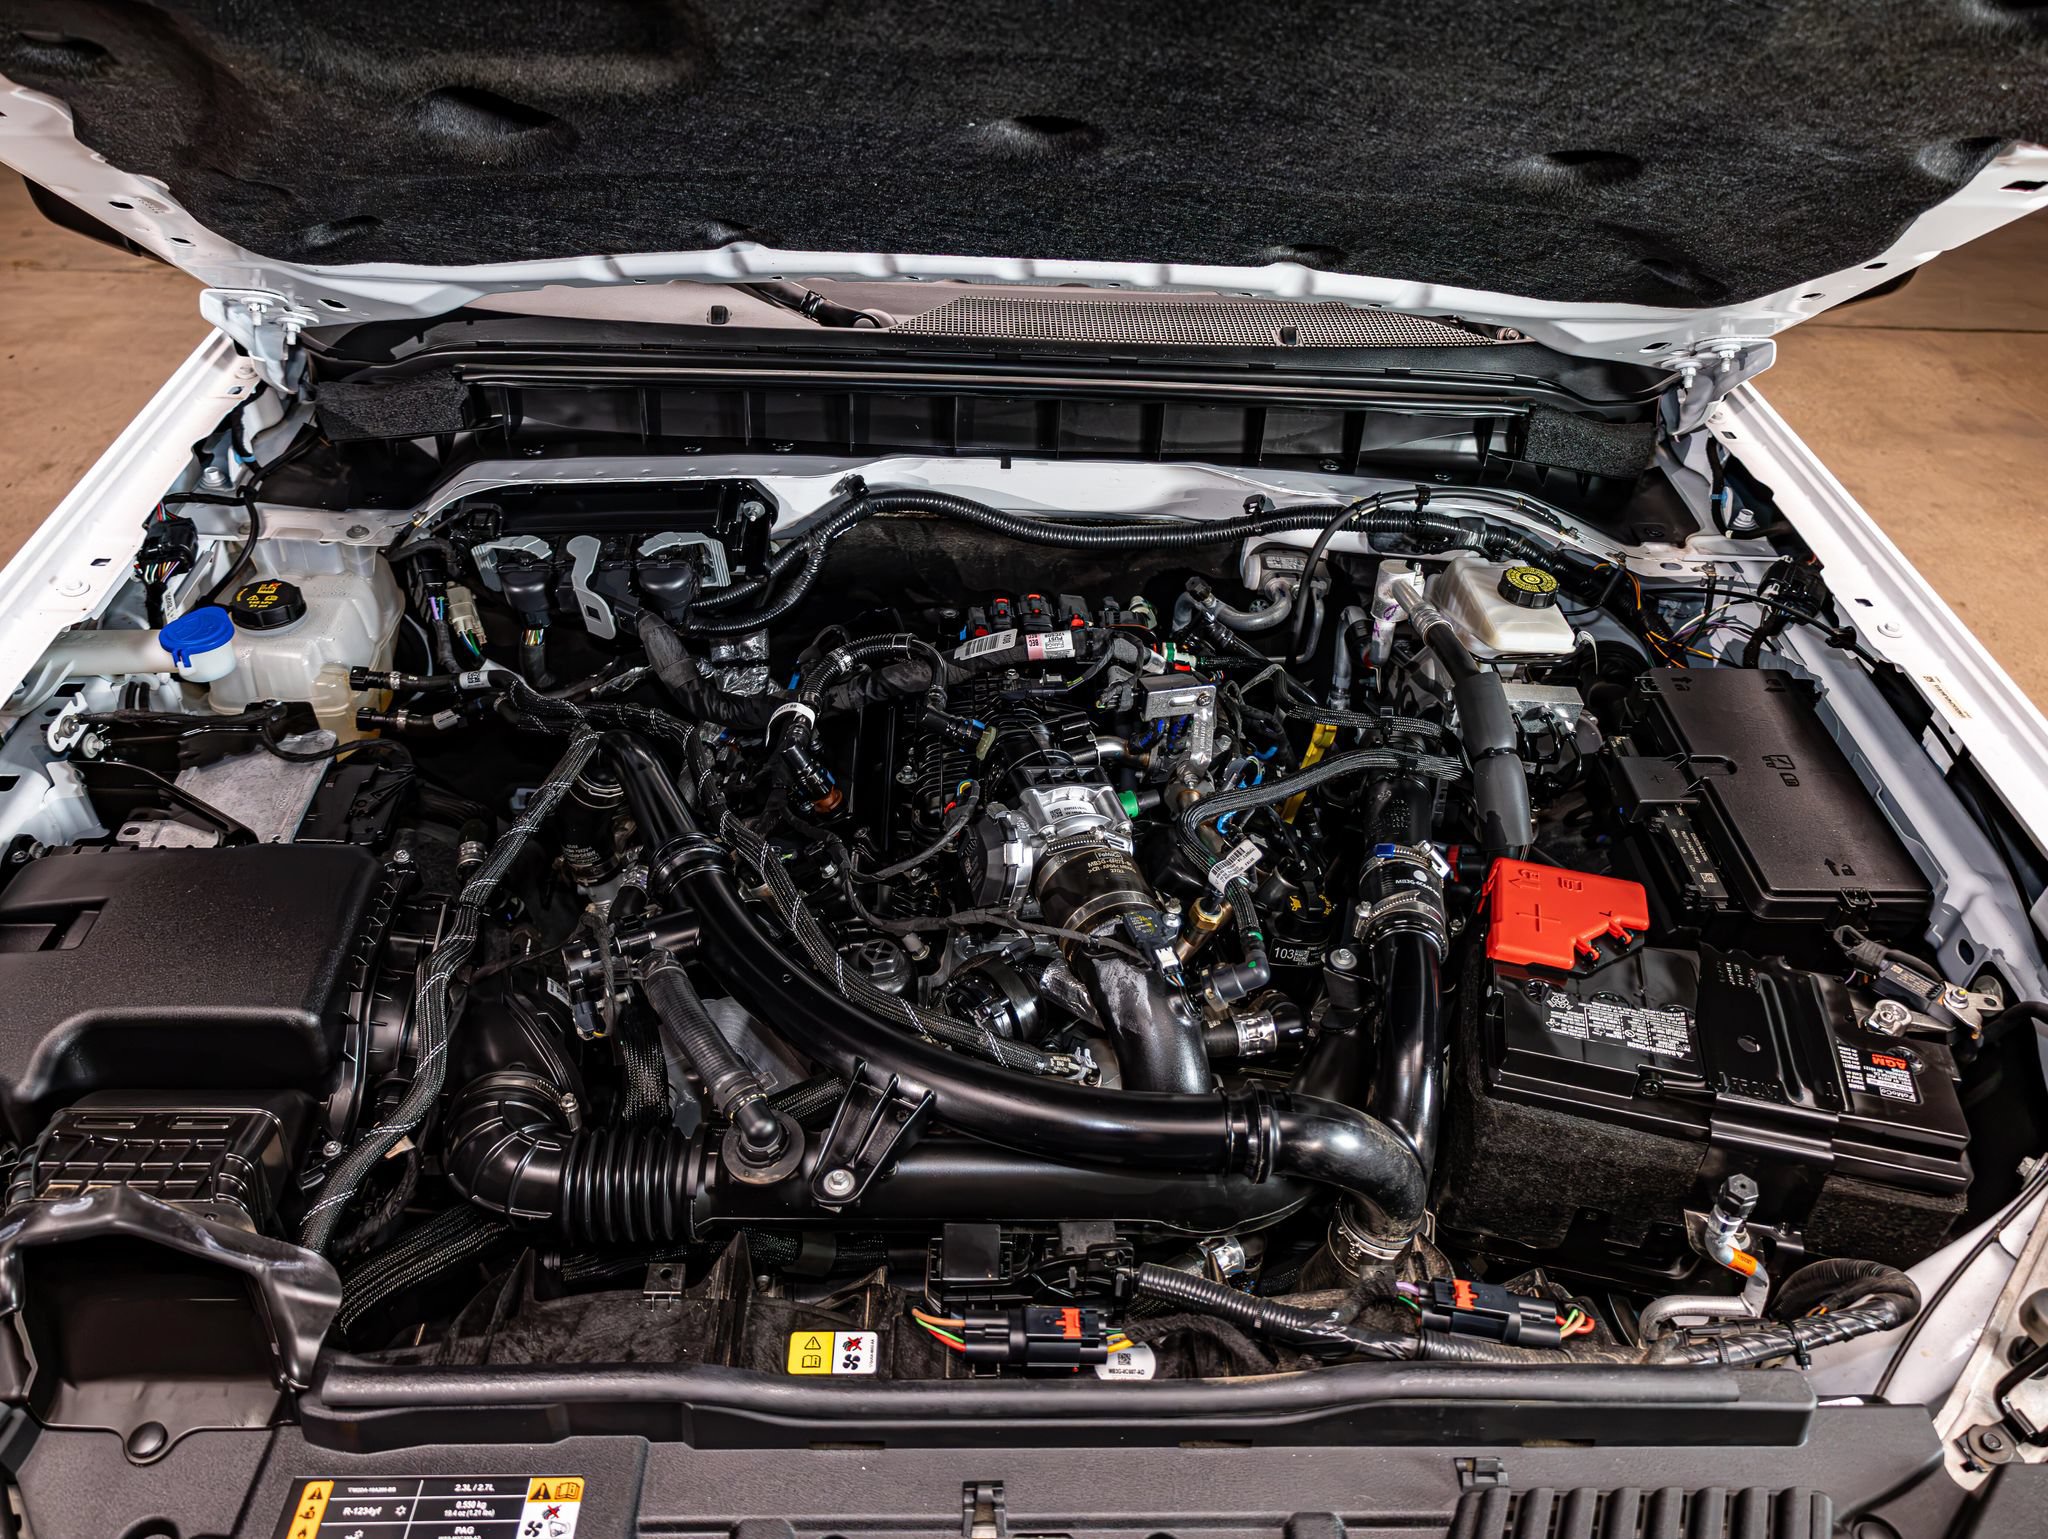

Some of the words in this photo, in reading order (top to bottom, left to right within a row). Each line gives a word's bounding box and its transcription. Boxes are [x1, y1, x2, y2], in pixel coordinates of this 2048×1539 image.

[1873, 1056, 1907, 1069] AGM
[1880, 1088, 1914, 1100] FoMoCo
[454, 1484, 472, 1492] 2.3L
[477, 1484, 495, 1492] 2.7L
[476, 1501, 487, 1510] kg
[342, 1506, 382, 1517] R-1234yf
[454, 1526, 475, 1535] PAG
